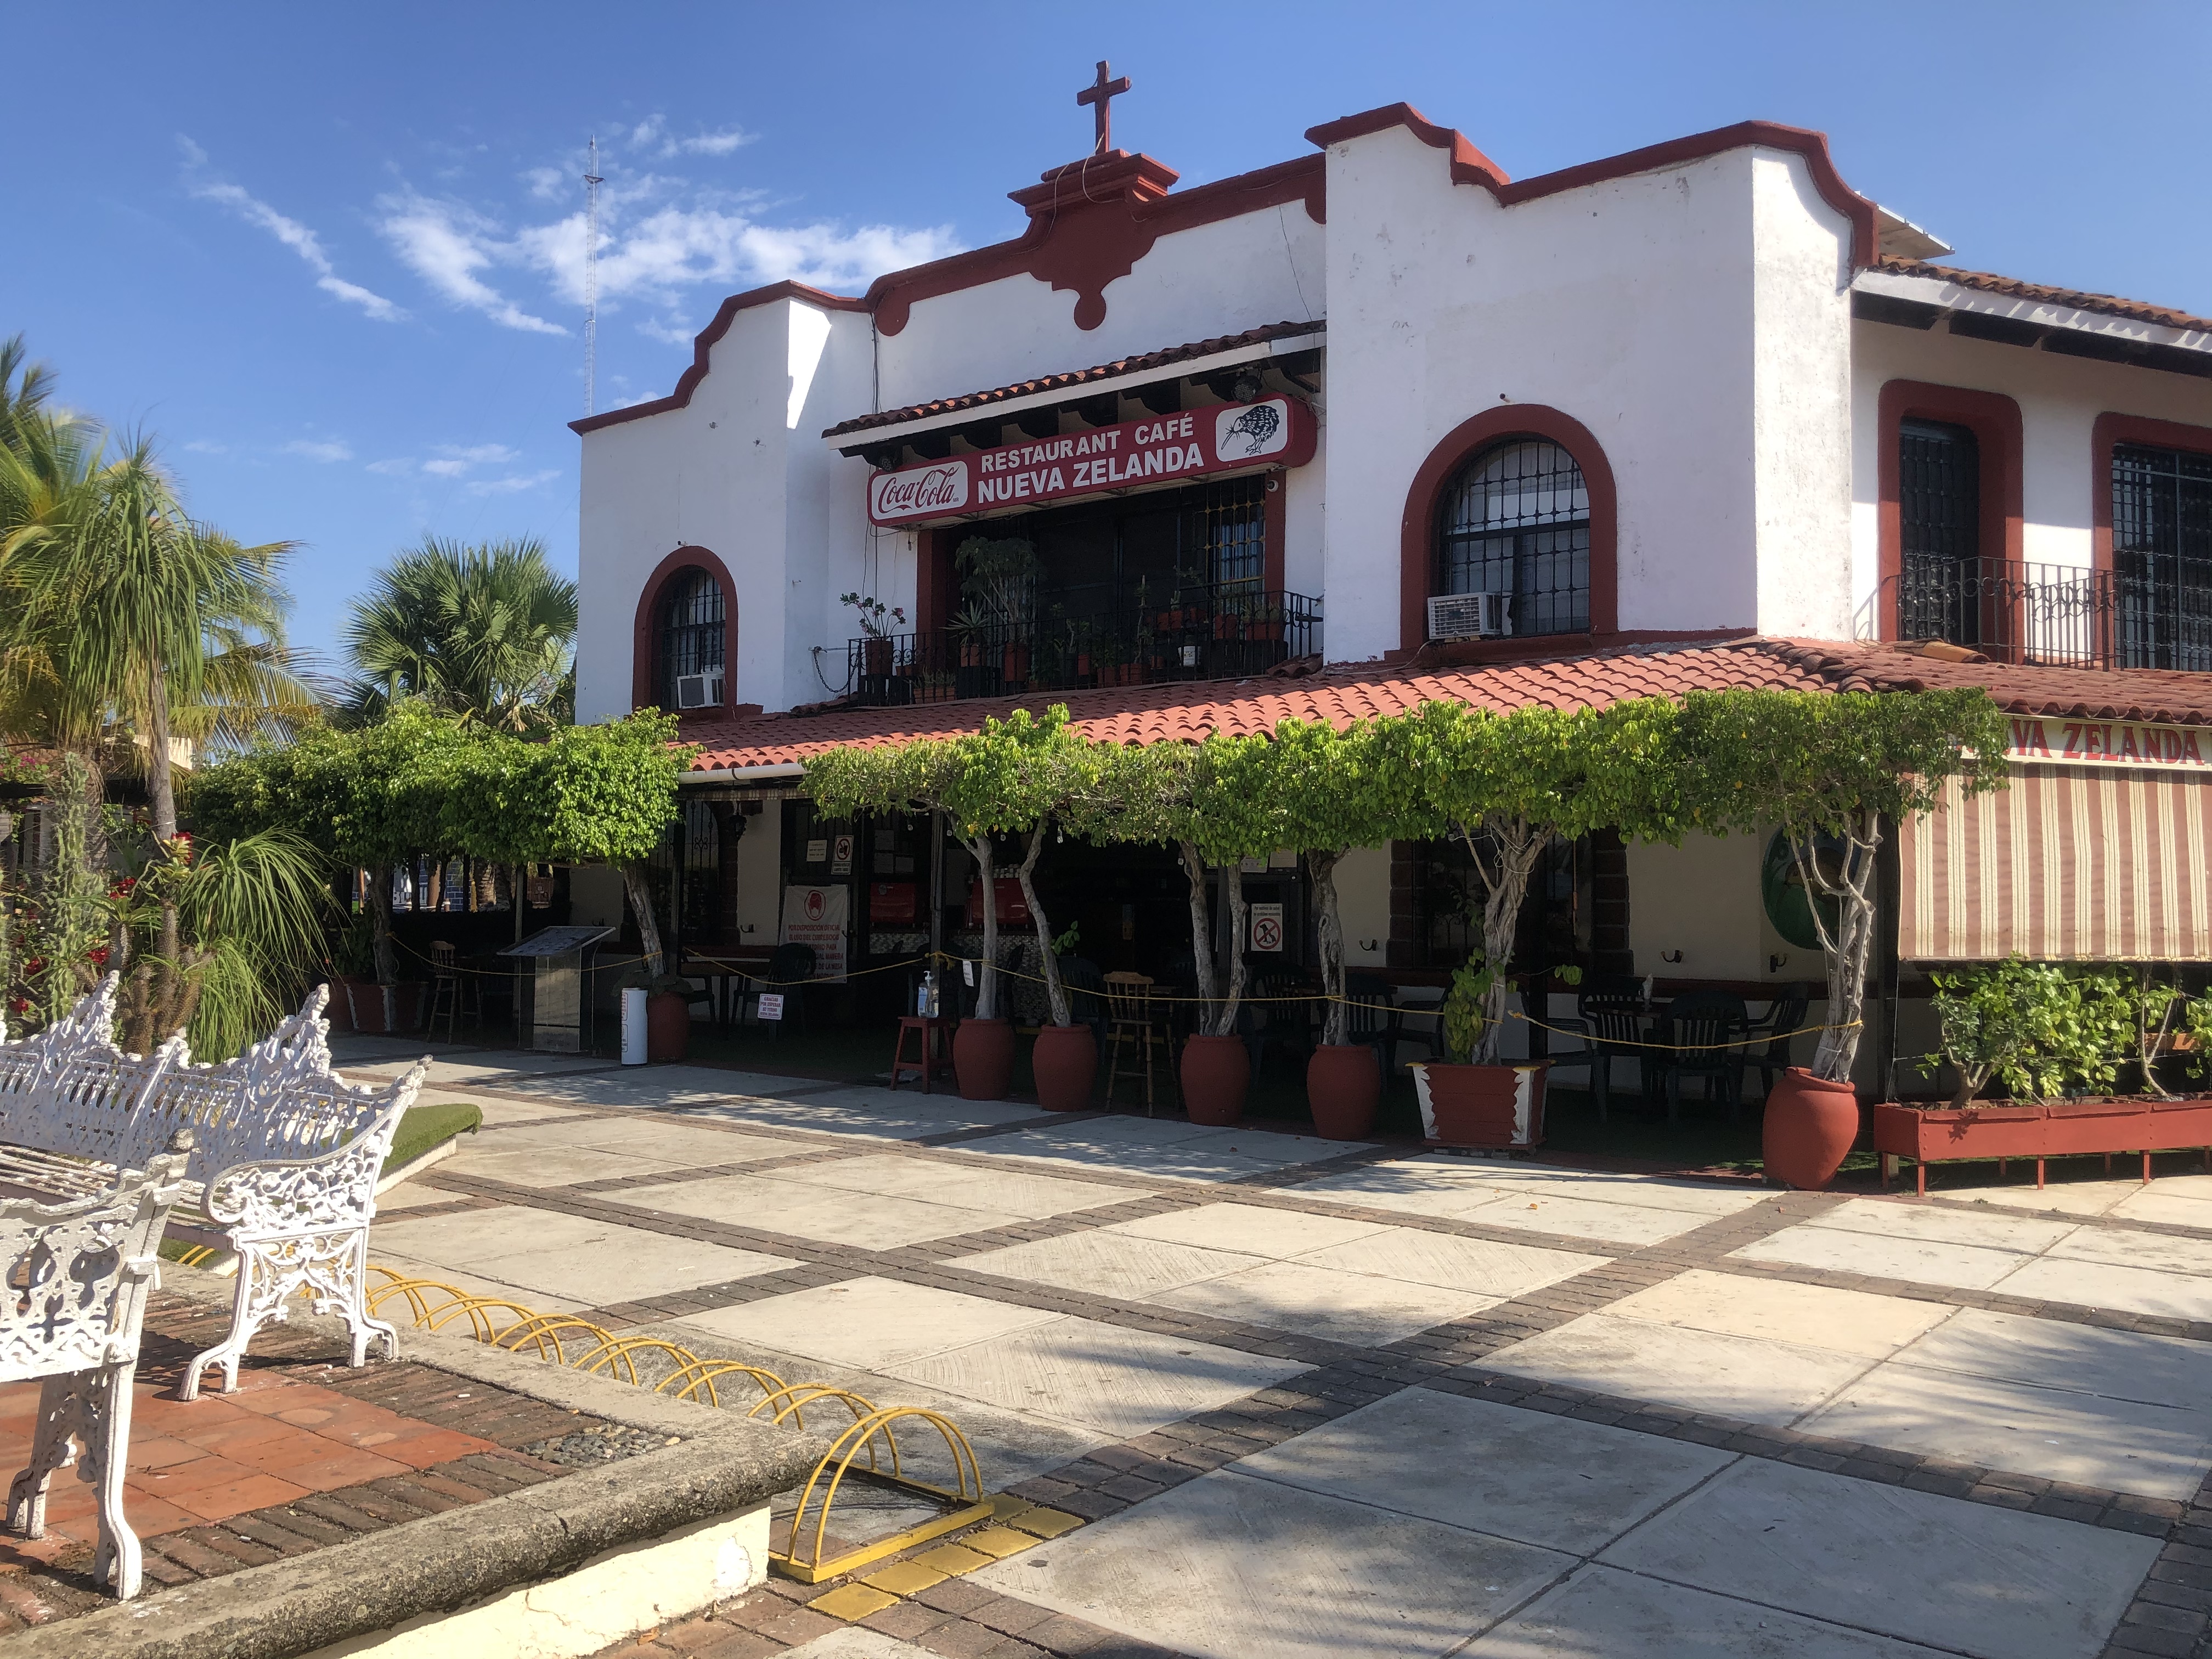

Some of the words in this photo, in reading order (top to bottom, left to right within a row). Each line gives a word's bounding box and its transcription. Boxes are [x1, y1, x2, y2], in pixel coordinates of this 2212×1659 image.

[981, 430, 1121, 473] RESTAURANT
[1134, 412, 1194, 445] CAFÉ
[878, 465, 960, 514] Coca-Cola
[978, 466, 1065, 504] NUEVA
[1073, 442, 1205, 488] ZELANDA
[2061, 722, 2206, 766] ZELANDA
